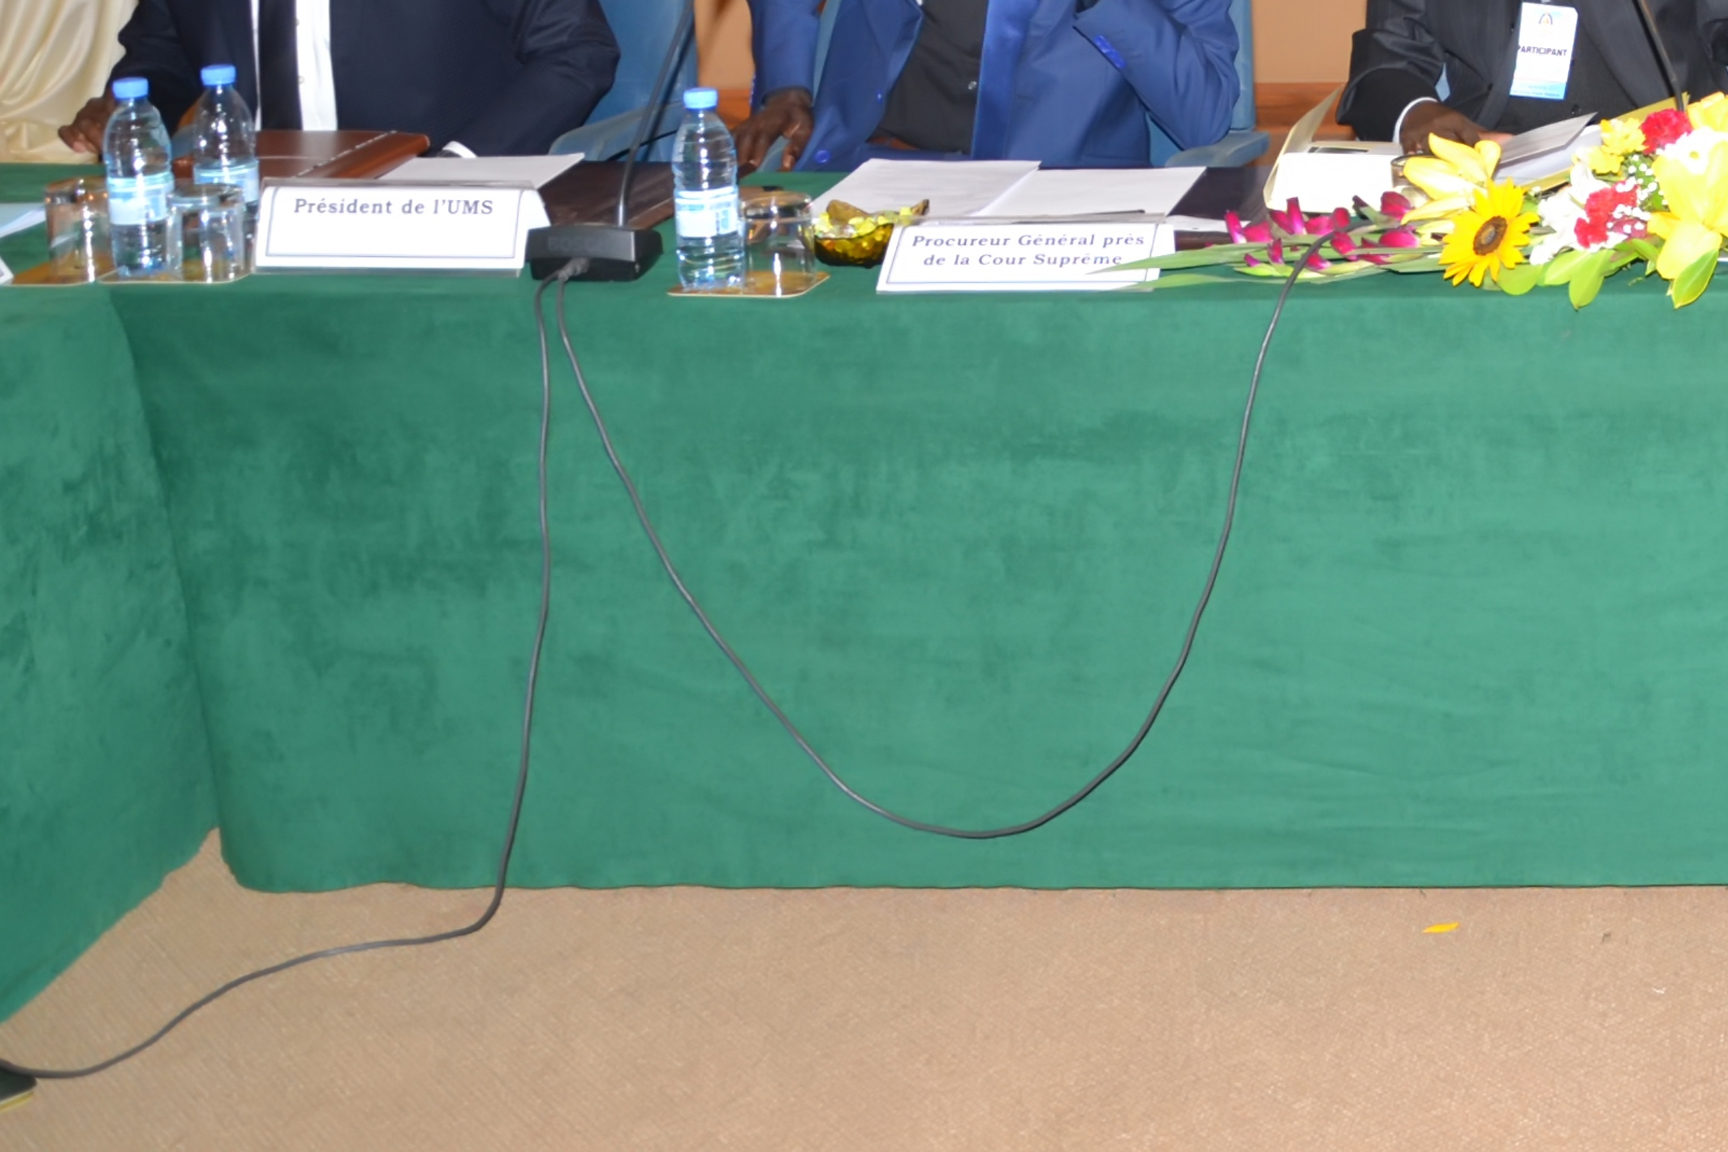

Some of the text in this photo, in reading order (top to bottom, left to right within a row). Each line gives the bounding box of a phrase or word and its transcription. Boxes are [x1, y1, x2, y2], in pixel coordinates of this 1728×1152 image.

[1518, 45, 1567, 57] ARTICIPANT
[293, 198, 494, 215] Président de l'UMS
[911, 233, 1145, 249] Procureur Général près
[922, 252, 1123, 268] de la Cour Suprême
